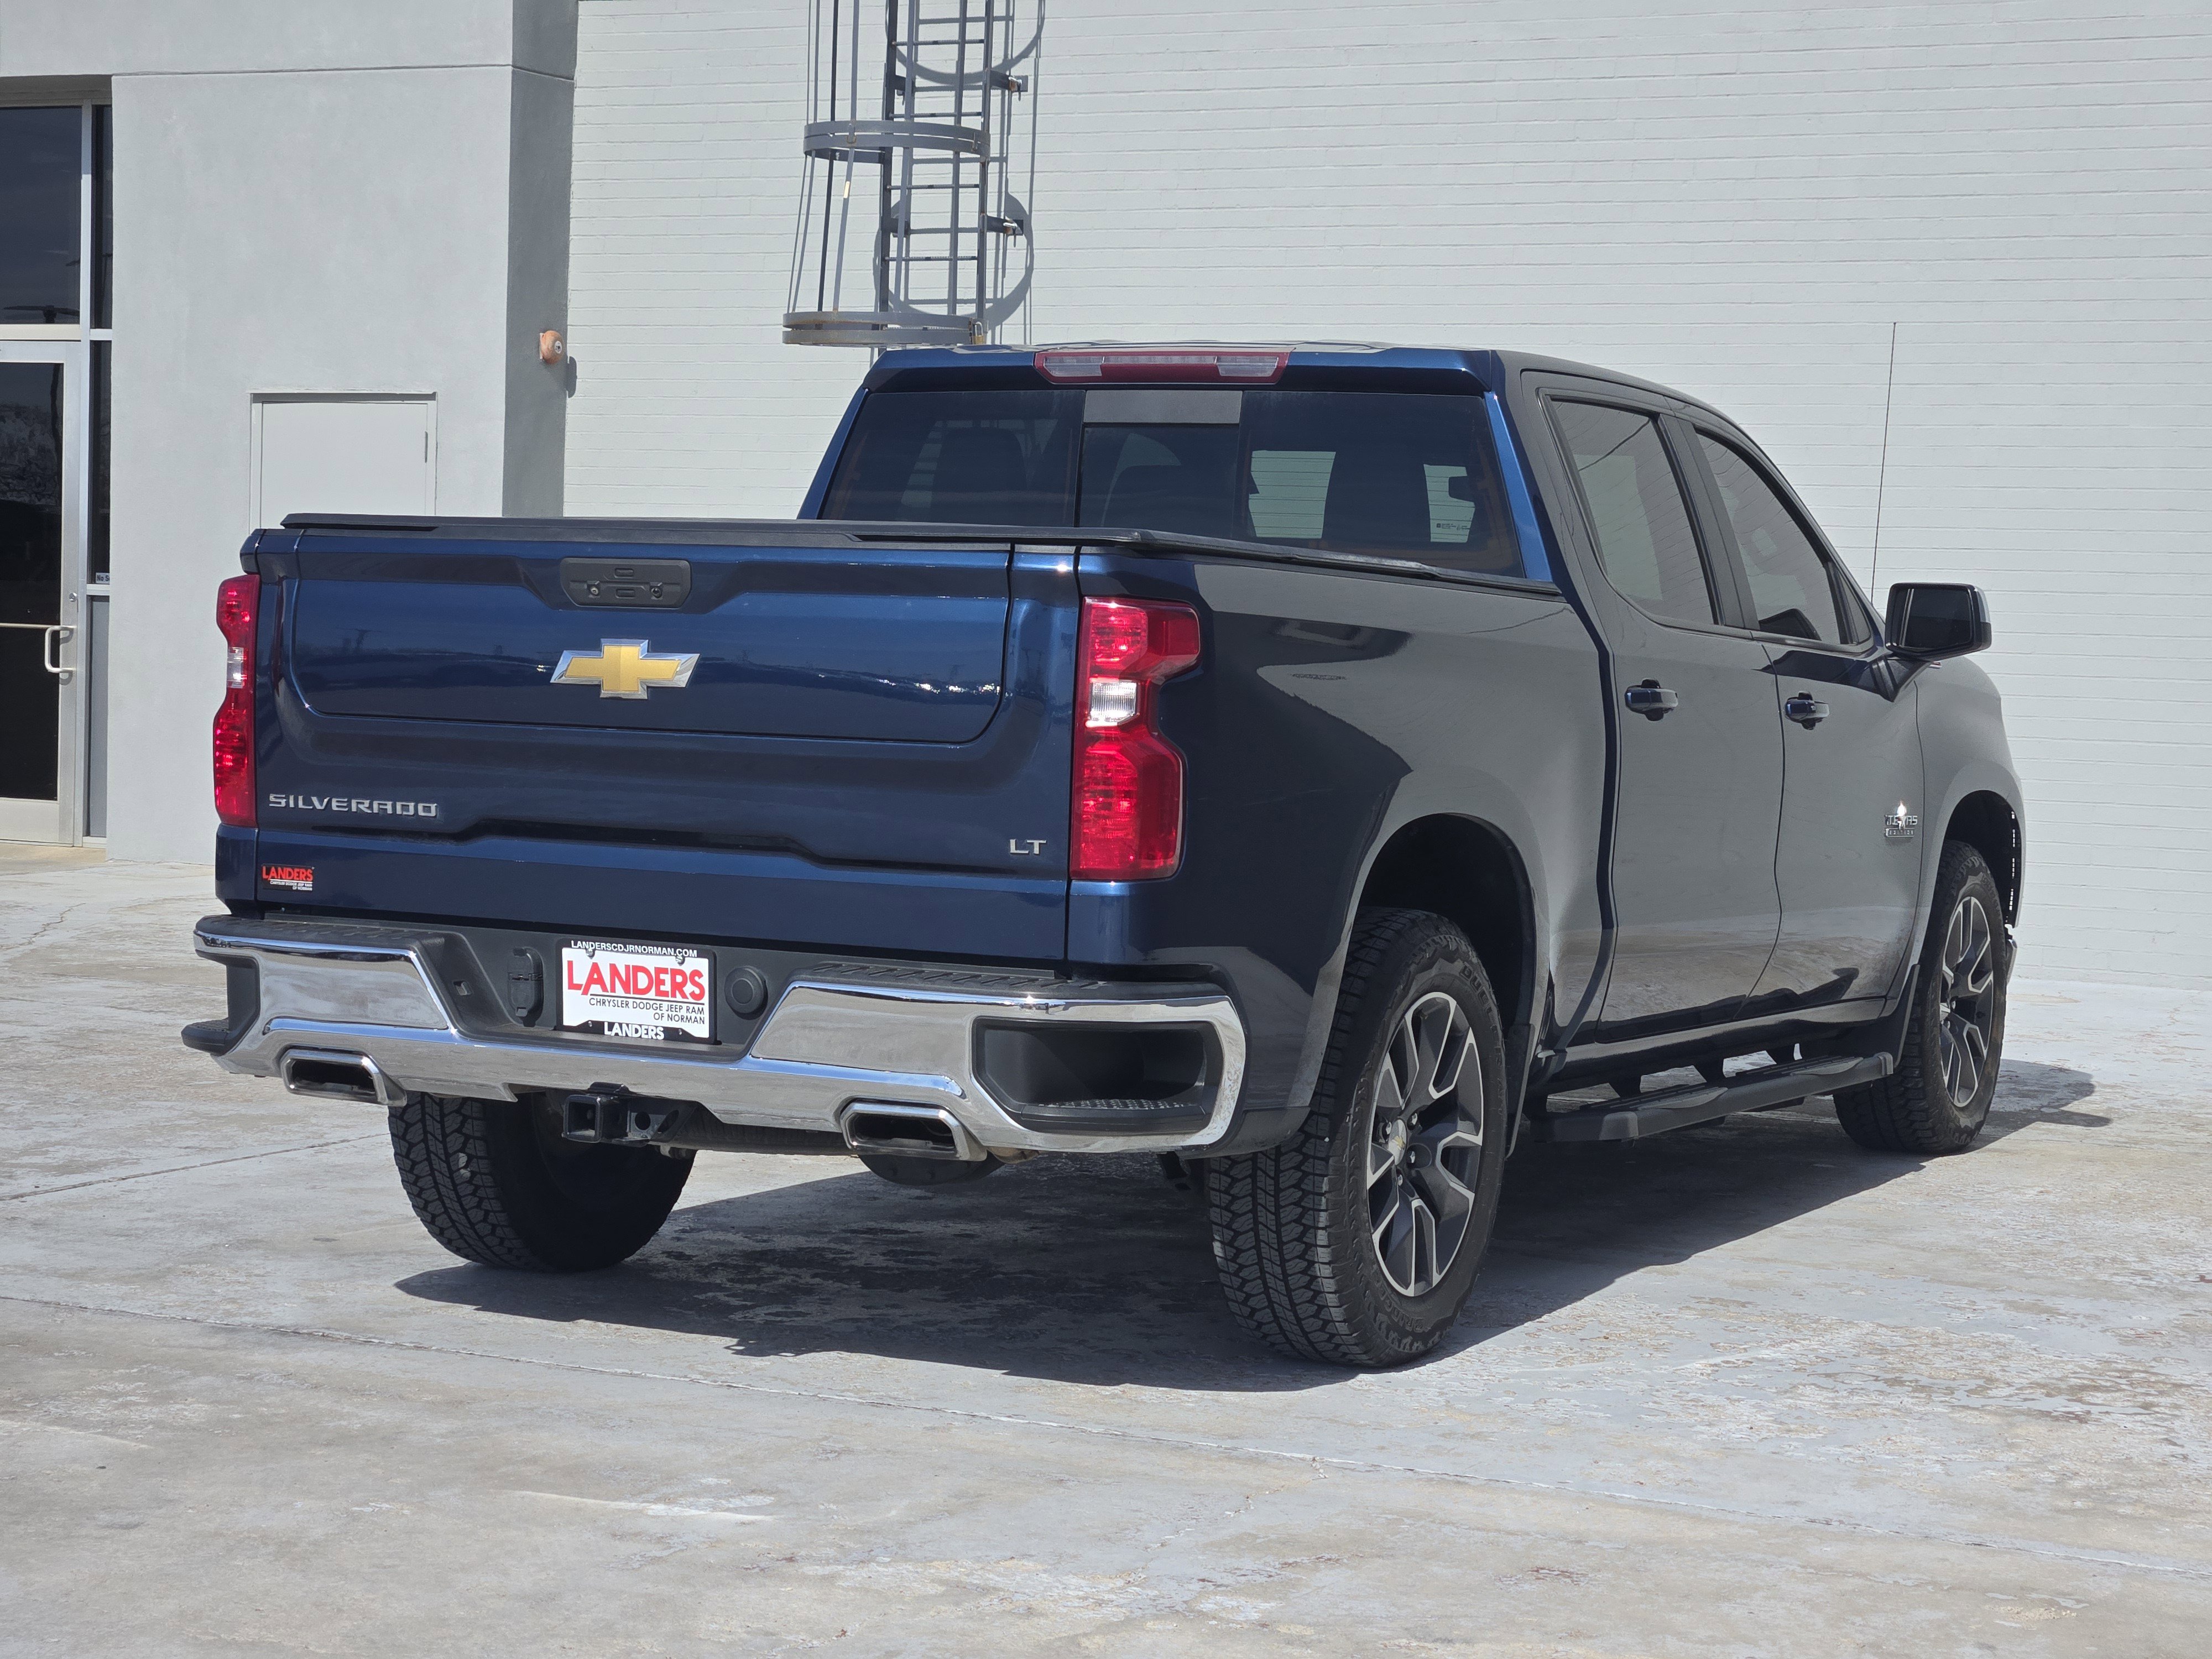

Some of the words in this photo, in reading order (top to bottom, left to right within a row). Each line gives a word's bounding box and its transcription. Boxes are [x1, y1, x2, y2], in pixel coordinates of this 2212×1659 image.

[269, 794, 437, 817] SILVERADO
[1010, 839, 1046, 855] LT
[262, 865, 314, 881] LANDERS
[571, 940, 697, 957] LANDERSCDJRNORMAN.COM
[567, 960, 706, 1001] LANDERS
[589, 998, 630, 1009] CHRYSLER
[632, 1001, 664, 1011] DODGE
[665, 1004, 683, 1013] JEEP
[686, 1006, 705, 1015] RAM
[653, 1012, 665, 1021] OF
[667, 1014, 705, 1025] NORMAN
[604, 1022, 664, 1040] LANDERS
